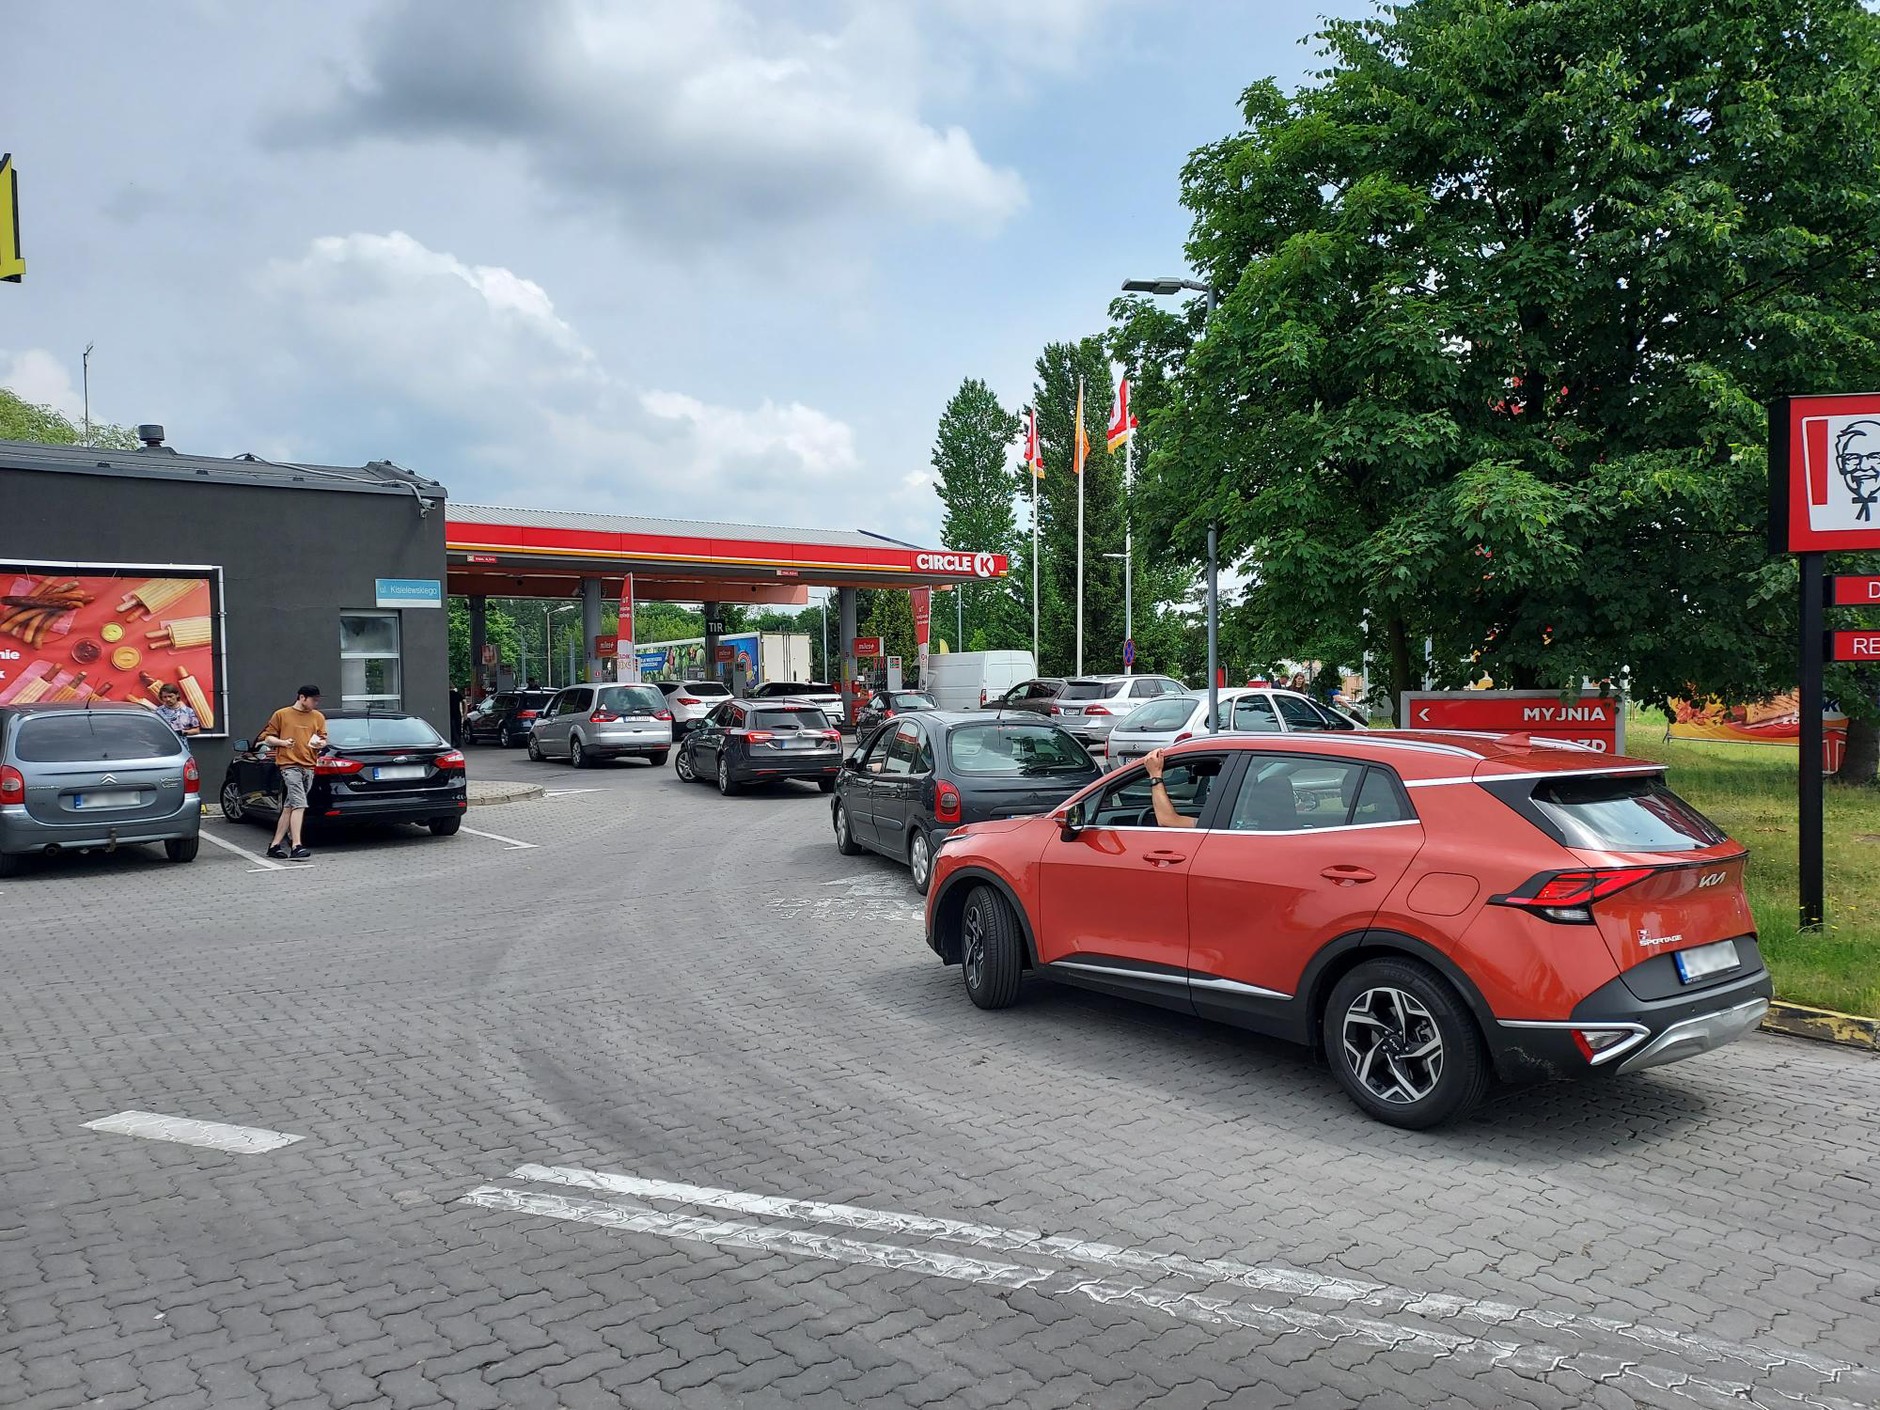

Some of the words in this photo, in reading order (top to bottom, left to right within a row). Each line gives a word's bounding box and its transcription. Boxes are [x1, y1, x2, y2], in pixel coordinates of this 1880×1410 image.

[916, 553, 972, 571] CIRCLE
[709, 622, 724, 633] TIR
[1523, 707, 1606, 721] MYJNIA
[1639, 934, 1683, 947] SPORTAGE
